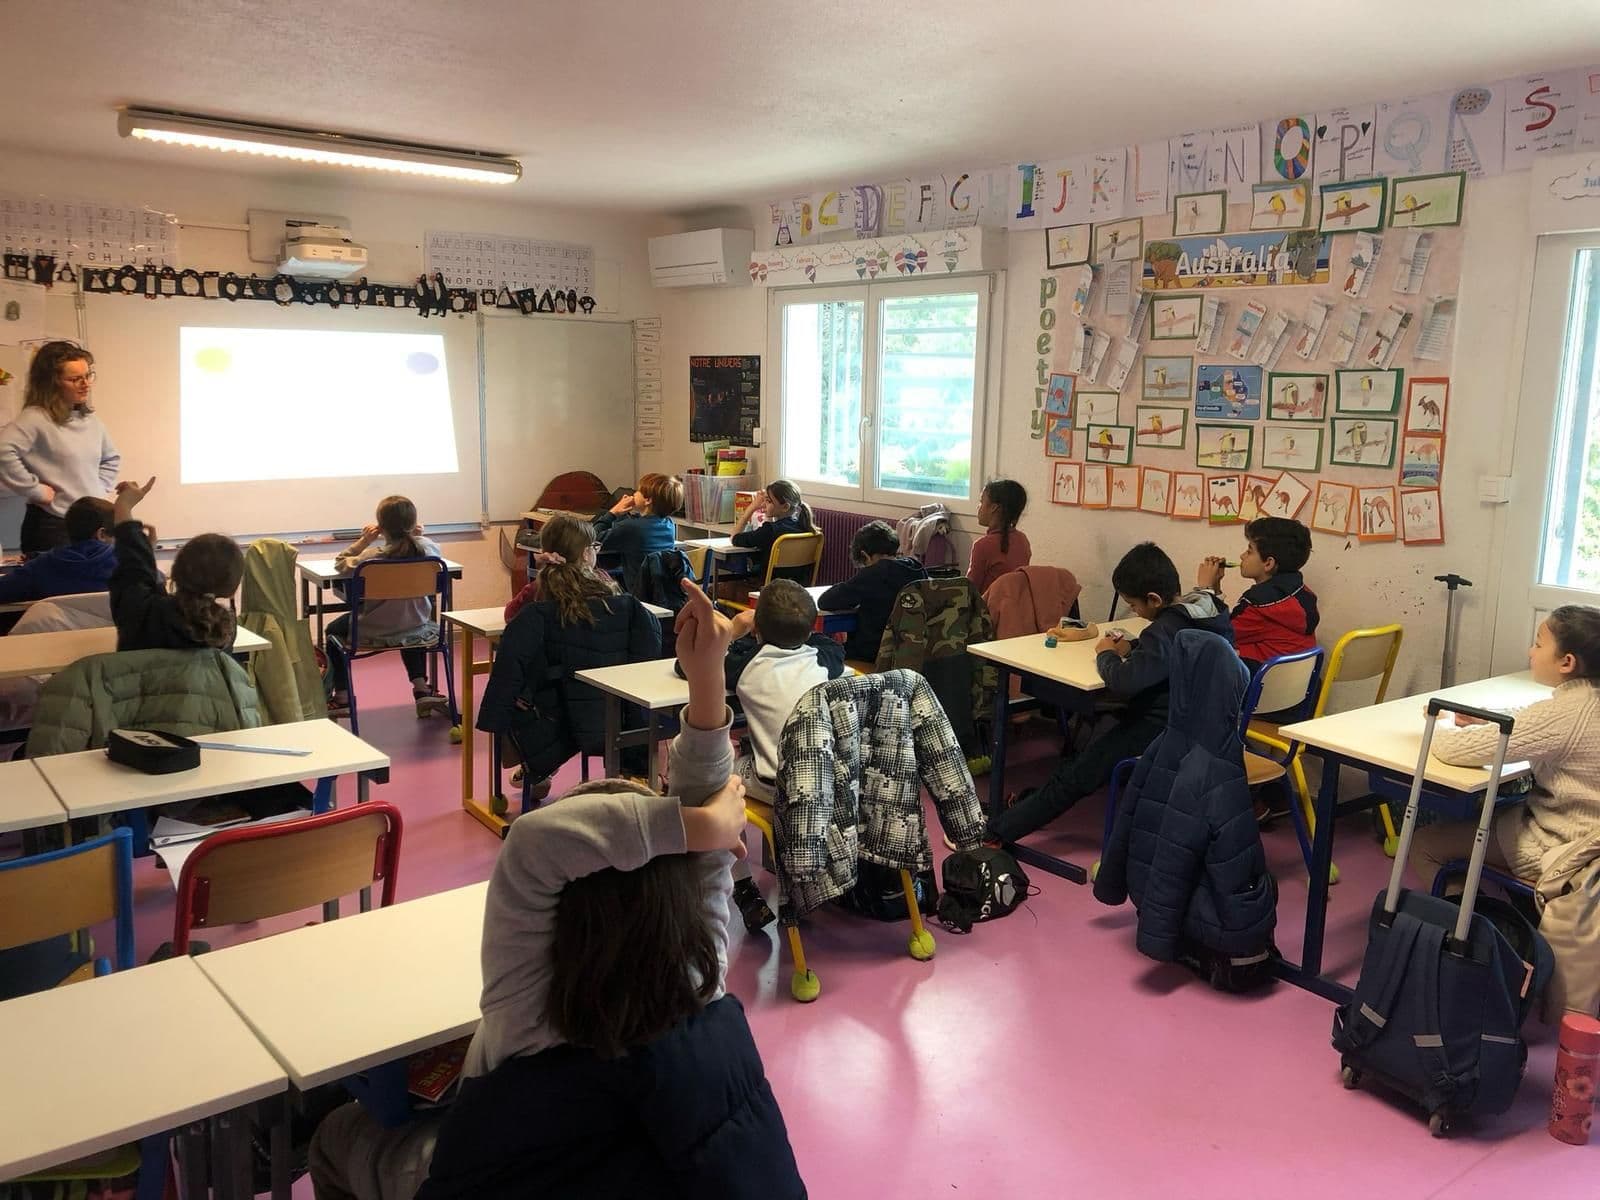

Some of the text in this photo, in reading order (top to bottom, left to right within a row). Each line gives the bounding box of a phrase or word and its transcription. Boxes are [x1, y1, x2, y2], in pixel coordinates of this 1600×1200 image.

[774, 208, 793, 246] A
[800, 202, 813, 237] B
[818, 191, 839, 226] C
[856, 185, 884, 232] D
[886, 184, 906, 228] E
[917, 185, 932, 222] F
[949, 173, 970, 212] G
[1016, 164, 1037, 219] I
[1053, 169, 1073, 213] J
[1091, 167, 1110, 204] K
[1223, 137, 1245, 185] N
[1273, 117, 1311, 180] O
[1339, 124, 1360, 182] P
[1383, 111, 1431, 173] Q
[1444, 87, 1492, 175] R
[1524, 85, 1557, 132] S
[1174, 244, 1292, 276] Australia
[690, 357, 711, 368] NOTRE
[1030, 276, 1057, 440] poetry
